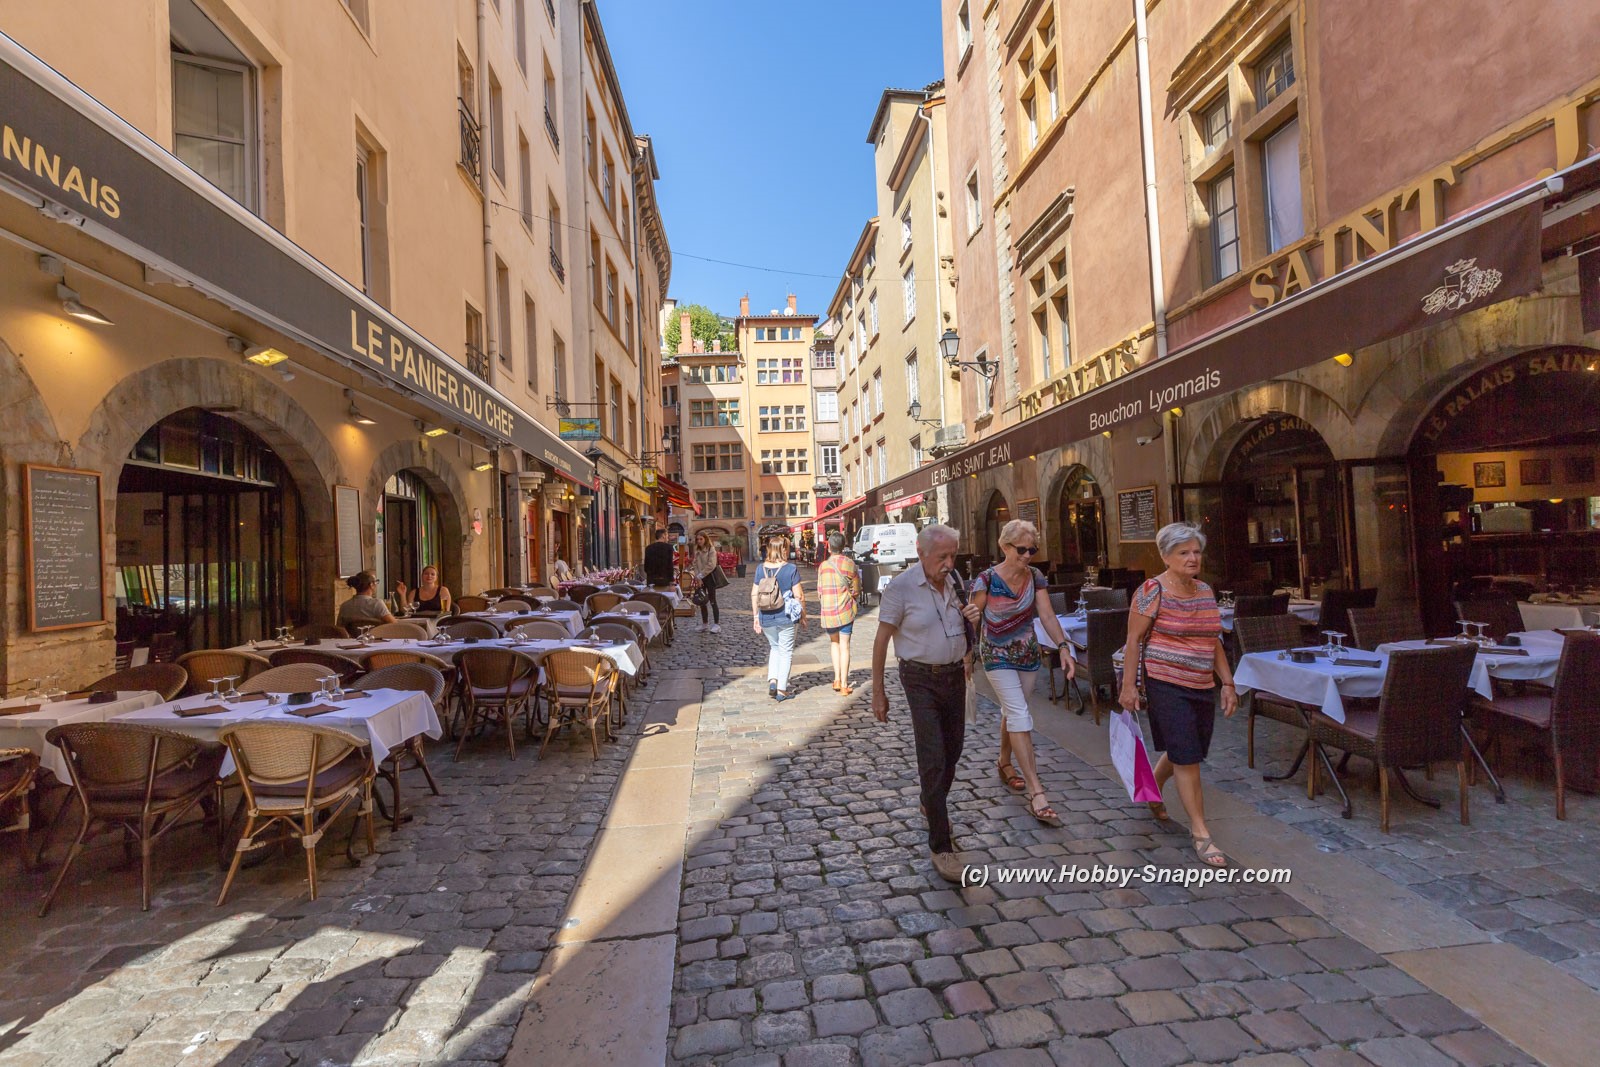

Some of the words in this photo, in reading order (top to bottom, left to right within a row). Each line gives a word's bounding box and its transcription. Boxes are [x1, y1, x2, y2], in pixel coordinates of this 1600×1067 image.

[3, 125, 120, 219] NNAIS
[1250, 165, 1456, 313] SAINT
[351, 309, 384, 365] LE
[390, 335, 460, 408] PANIER
[462, 384, 483, 421] DU
[485, 399, 515, 438] CHEF
[1089, 399, 1142, 431] Bouchon
[1149, 367, 1222, 413] Lyonnais
[1444, 365, 1516, 417] PALAIS
[931, 470, 940, 486] LE
[940, 461, 962, 483] PALAIS
[964, 452, 984, 475] SAINT
[987, 441, 1011, 467] JEAN
